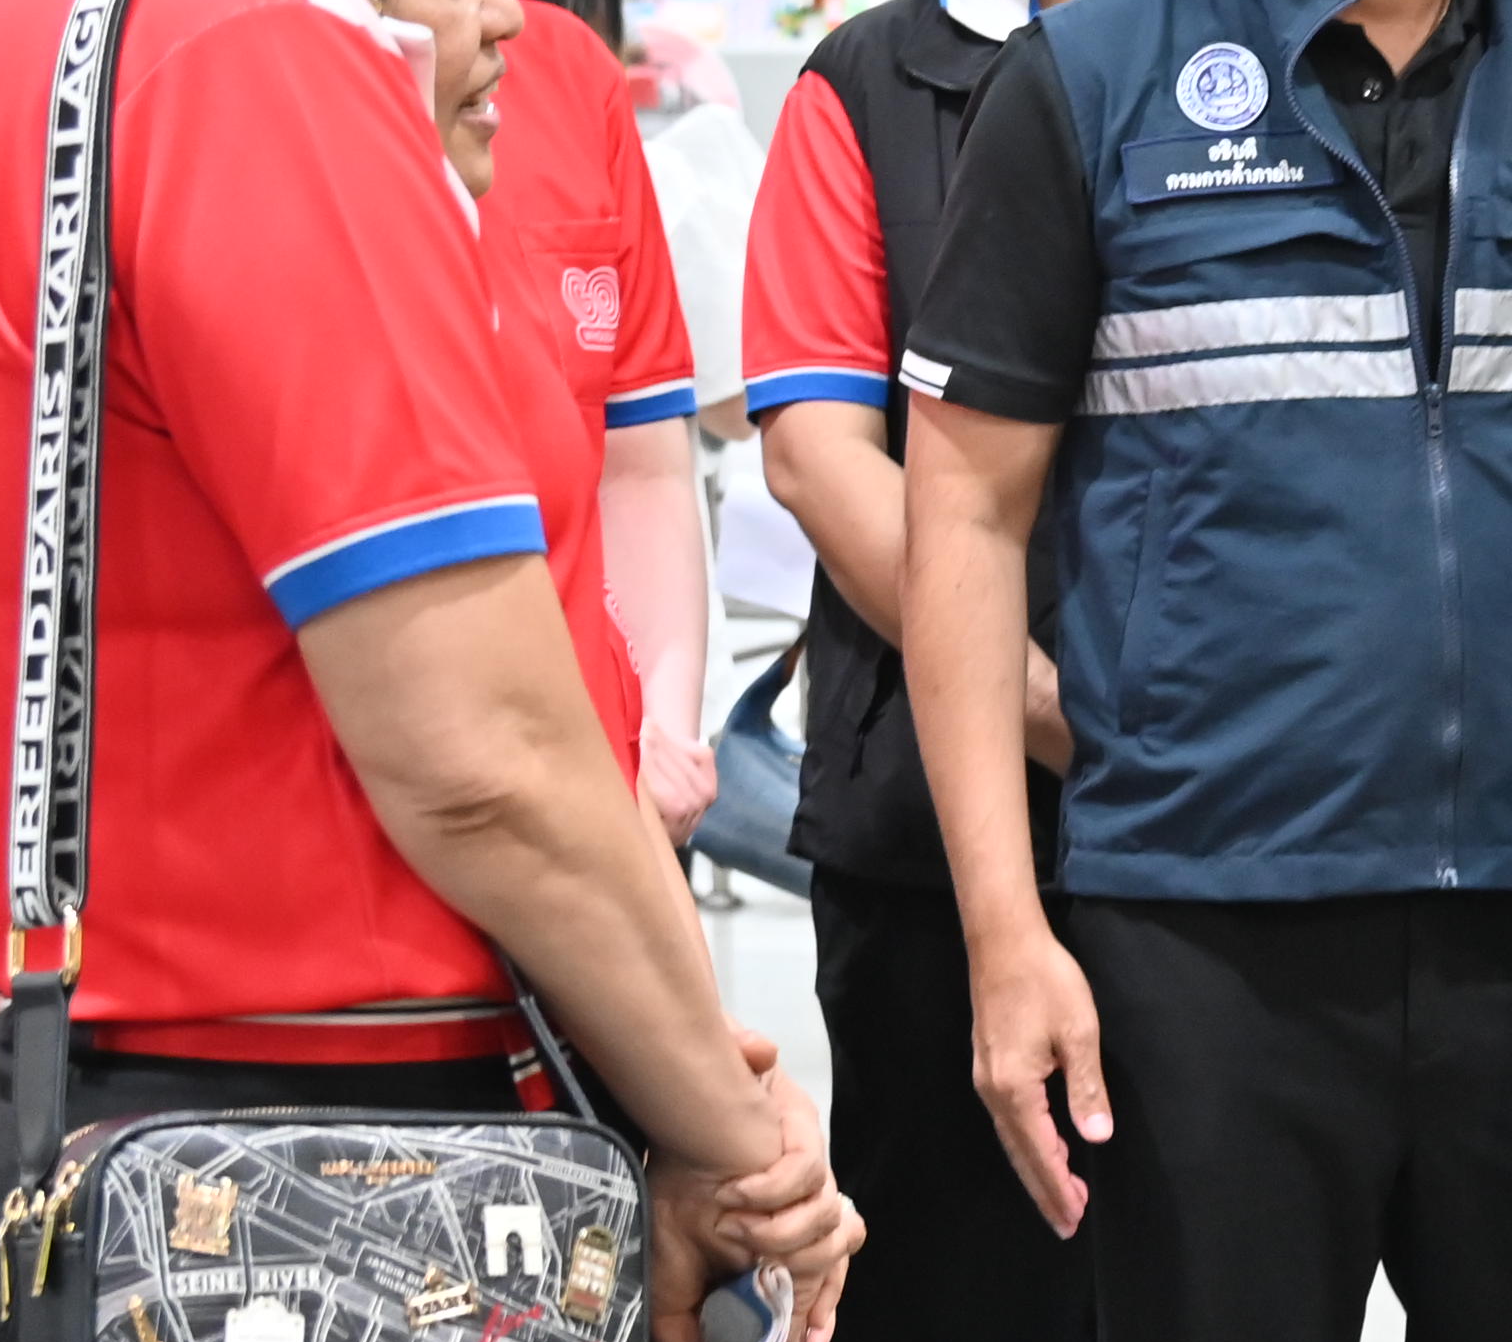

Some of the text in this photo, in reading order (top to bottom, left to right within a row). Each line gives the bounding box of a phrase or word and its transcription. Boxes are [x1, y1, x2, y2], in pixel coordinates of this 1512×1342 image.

[1165, 160, 1304, 191] กรมการค้าภายใน
[42, 152, 84, 346] KARL
[29, 370, 66, 591] PARIS
[176, 1267, 321, 1294] SEINE RIVER
